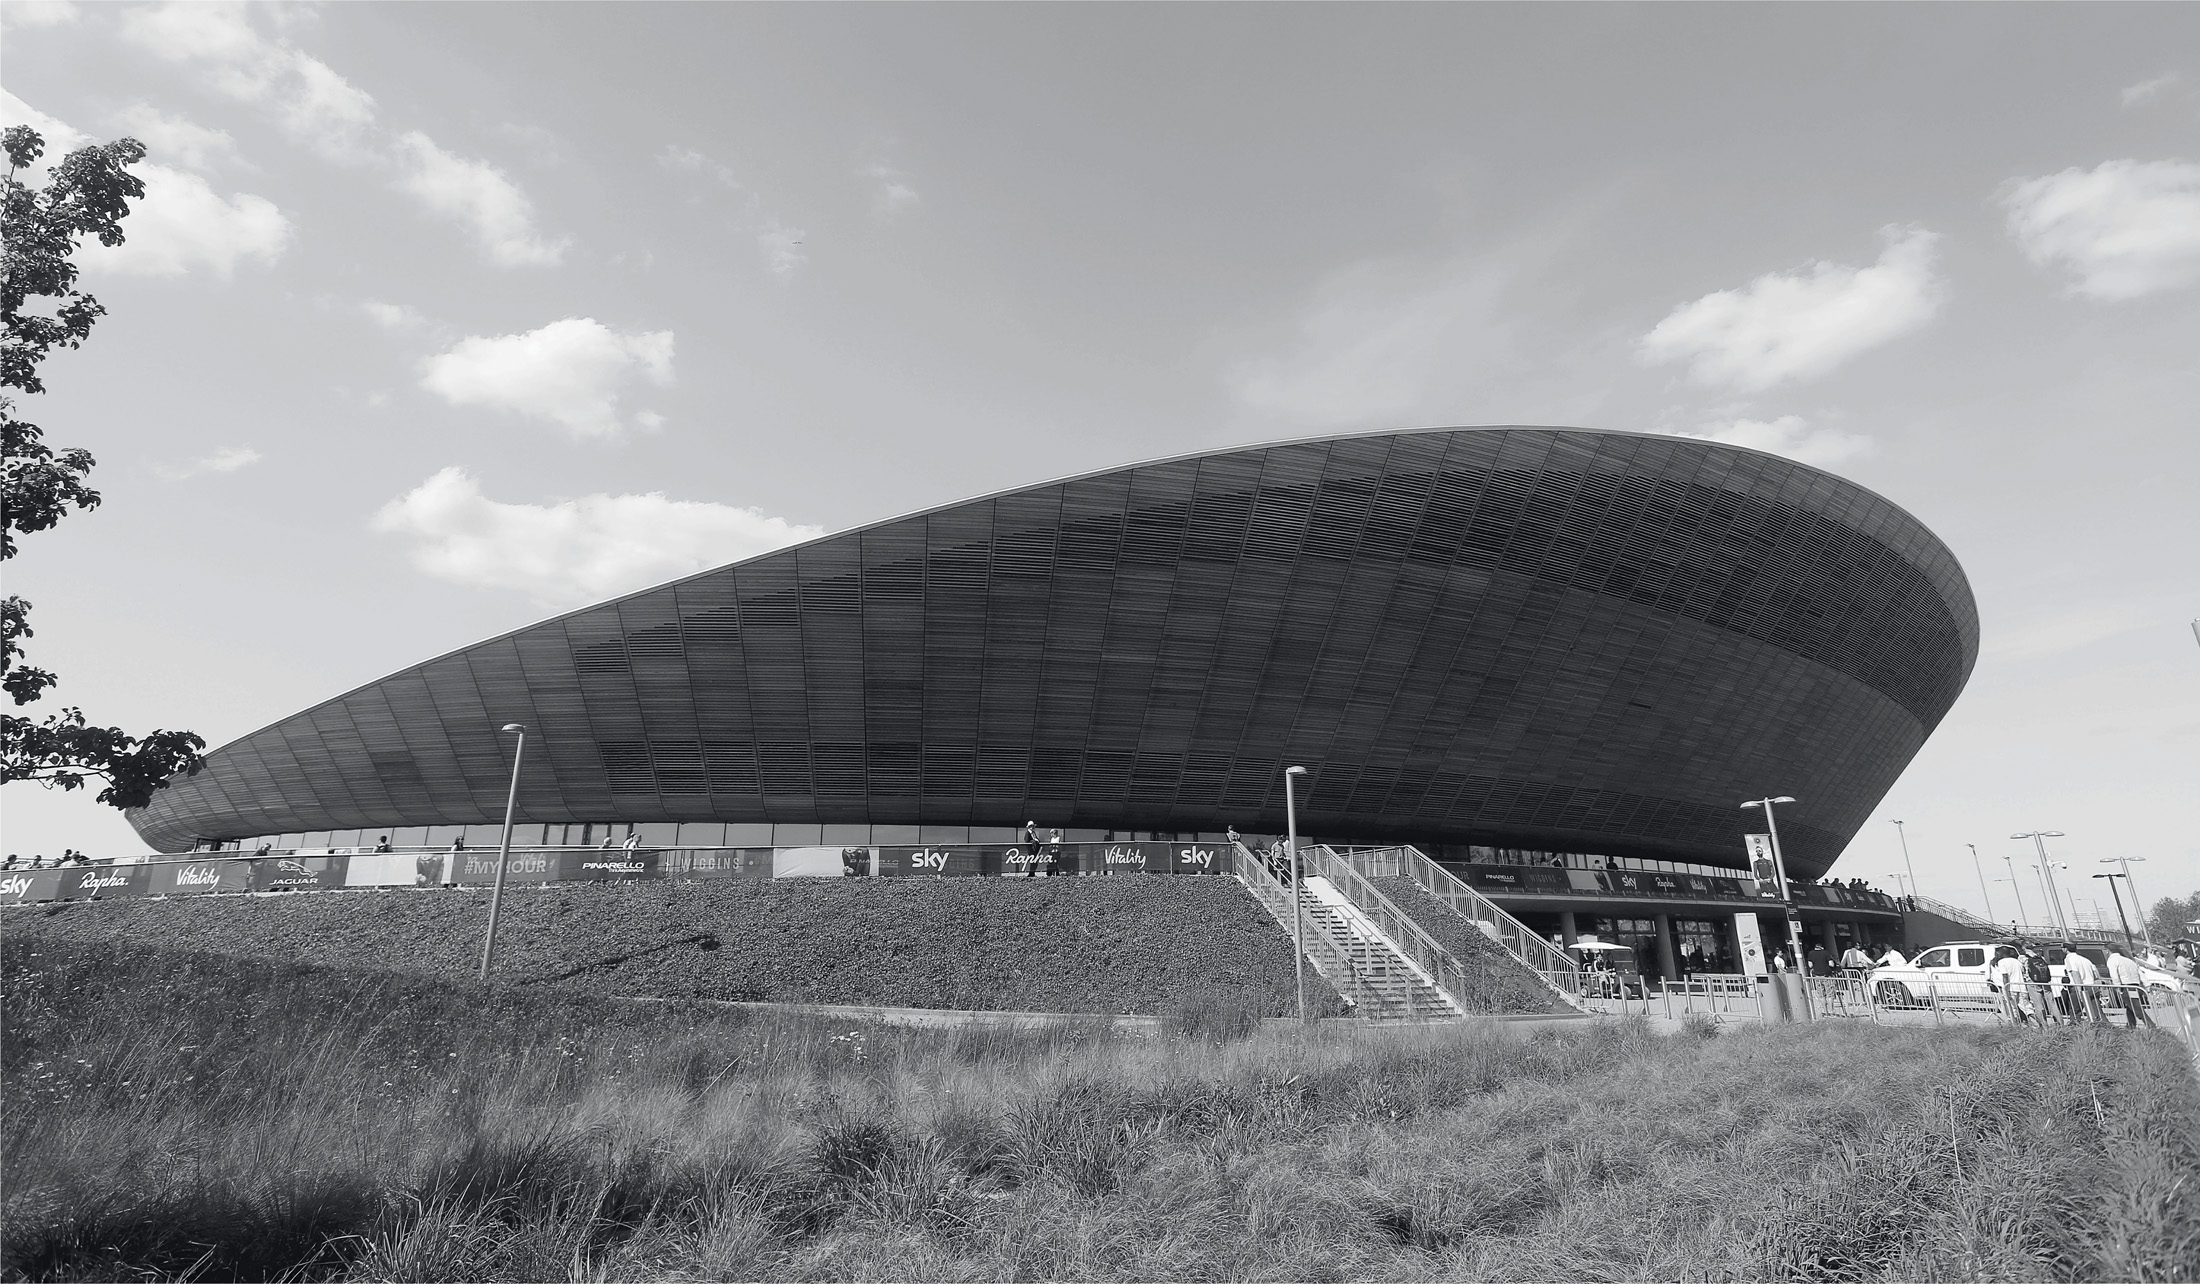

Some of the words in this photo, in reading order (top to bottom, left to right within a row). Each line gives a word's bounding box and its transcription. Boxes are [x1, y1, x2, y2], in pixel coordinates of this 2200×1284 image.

[582, 862, 645, 870] PINARELLO
[681, 857, 740, 870] WIGGINS
[911, 848, 949, 872] sky
[1005, 847, 1057, 871] Rapha.
[1104, 845, 1146, 870] Vitality
[1180, 845, 1214, 868] sky
[0, 874, 34, 898] sky
[79, 869, 129, 896] Rapha.
[177, 865, 220, 890] Vitality
[1622, 874, 1637, 890] sky
